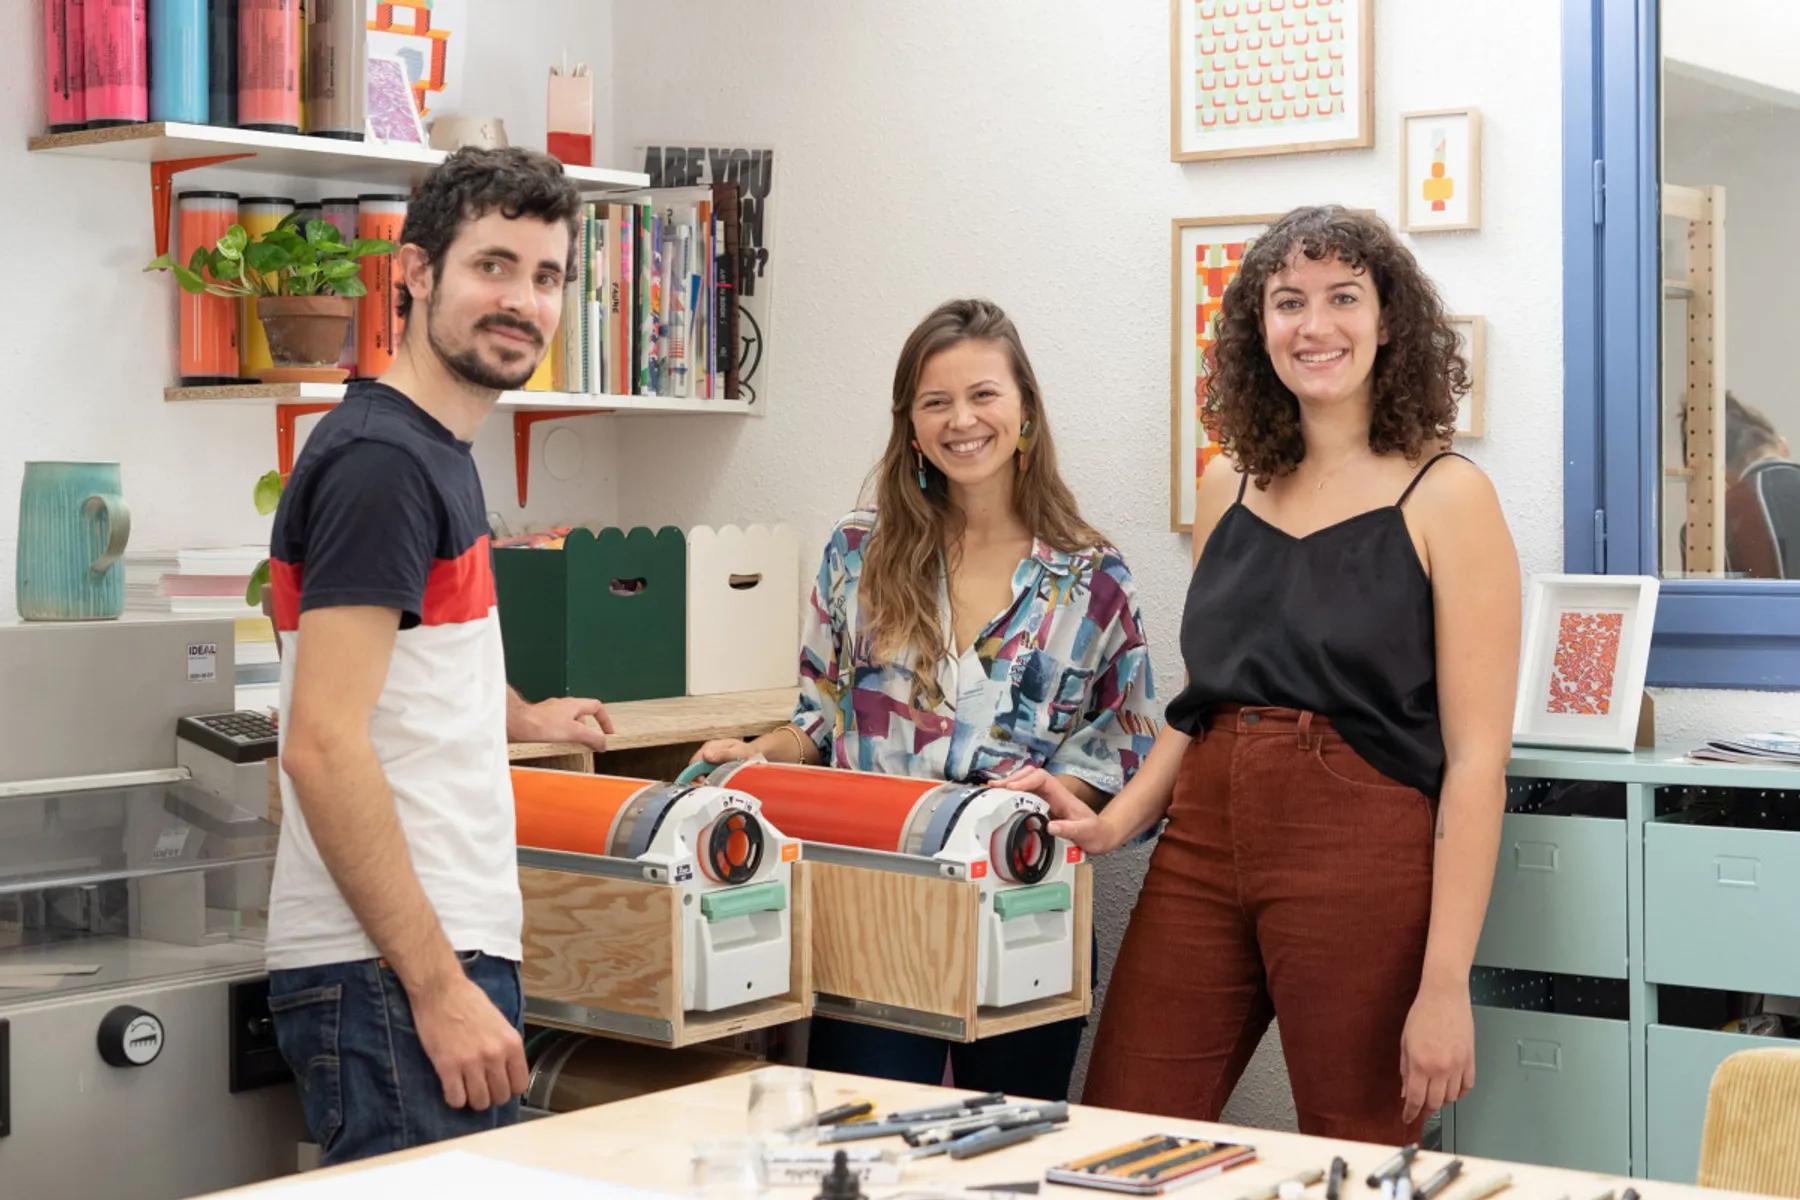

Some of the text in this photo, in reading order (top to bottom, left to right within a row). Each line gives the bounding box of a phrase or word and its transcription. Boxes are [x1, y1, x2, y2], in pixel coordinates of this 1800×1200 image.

[644, 147, 773, 199] ARE YOU
[188, 645, 216, 655] IDEAL
